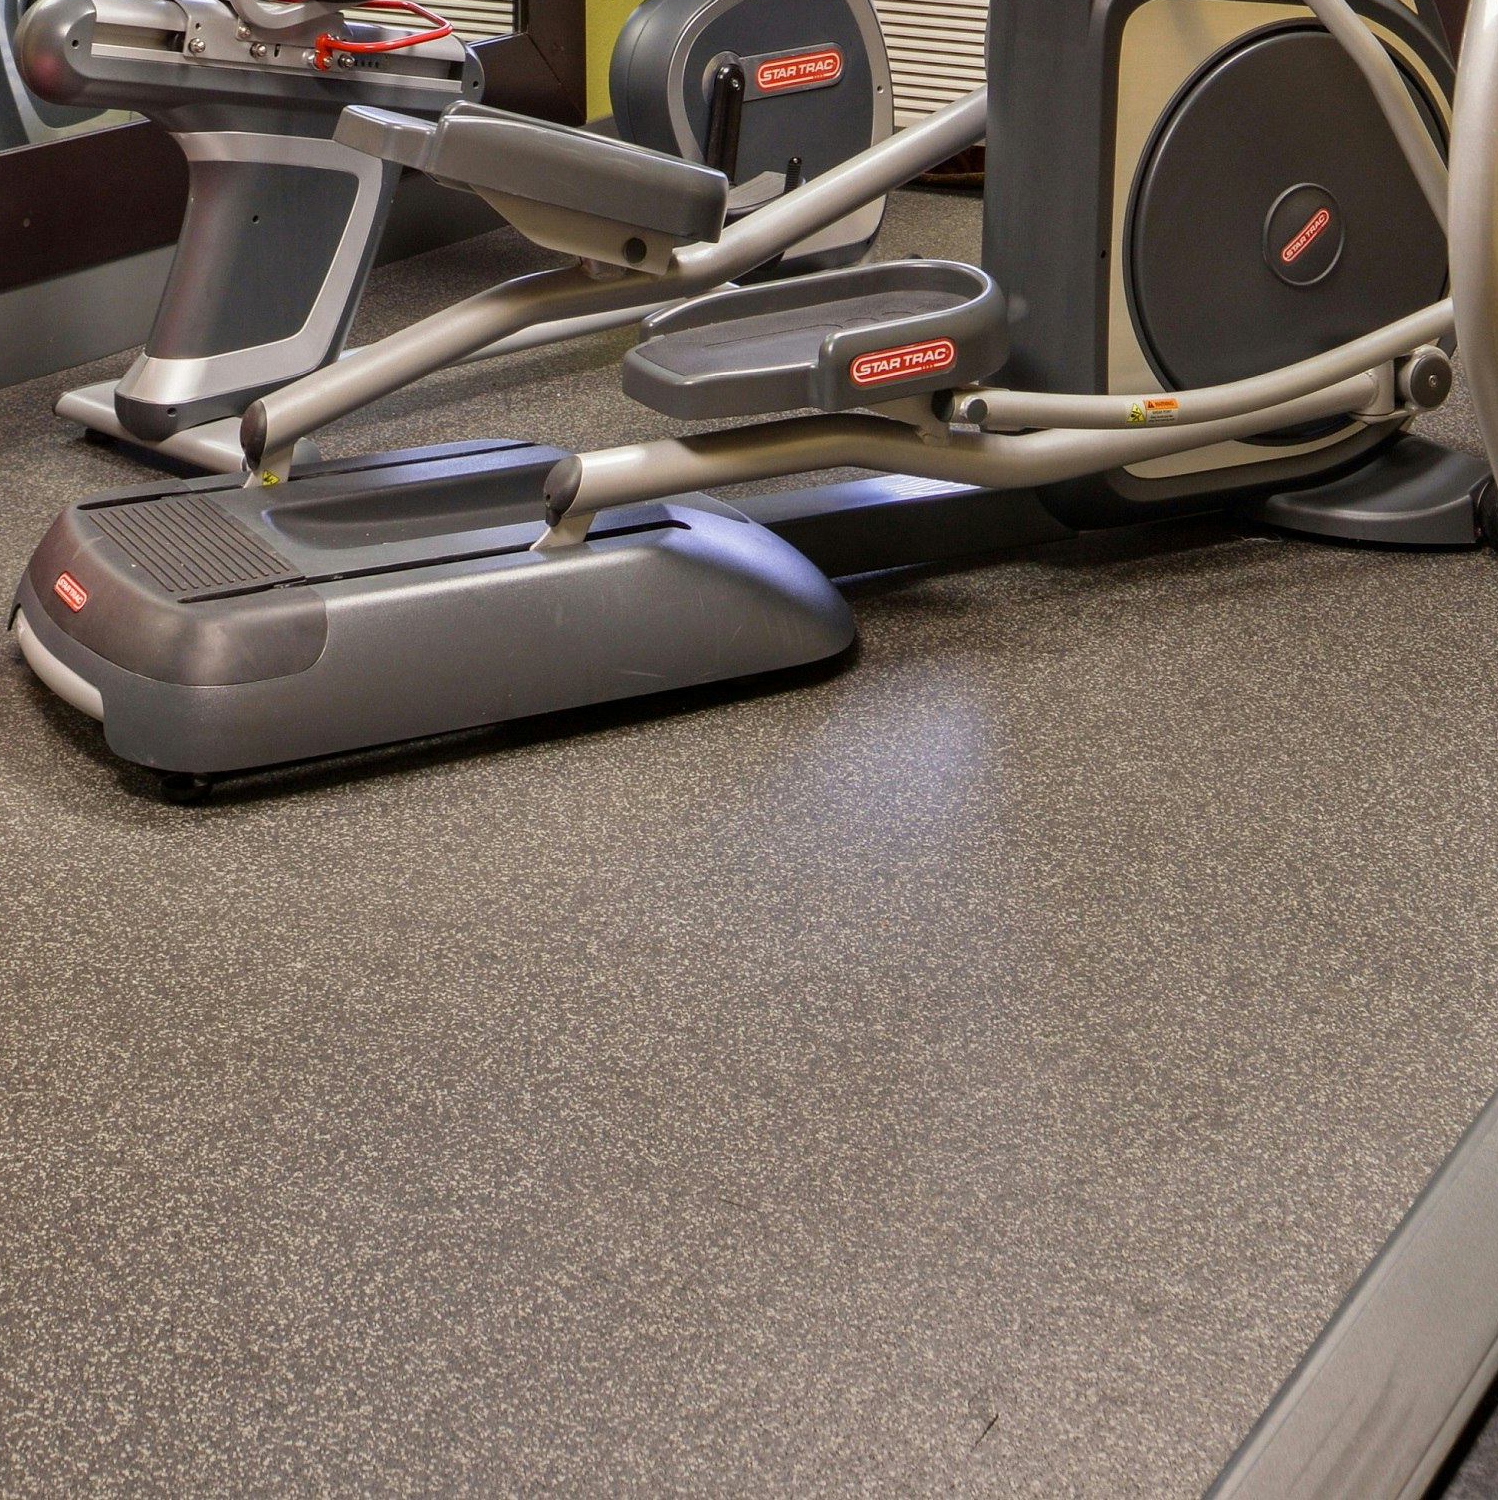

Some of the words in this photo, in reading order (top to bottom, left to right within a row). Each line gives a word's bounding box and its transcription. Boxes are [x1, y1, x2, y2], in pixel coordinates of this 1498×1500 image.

[761, 66, 797, 81] STAR
[798, 59, 834, 74] TRAC
[1286, 235, 1307, 257] STAR
[1305, 214, 1325, 238] TRAC
[859, 357, 901, 375] STAR
[903, 348, 946, 366] TRAC
